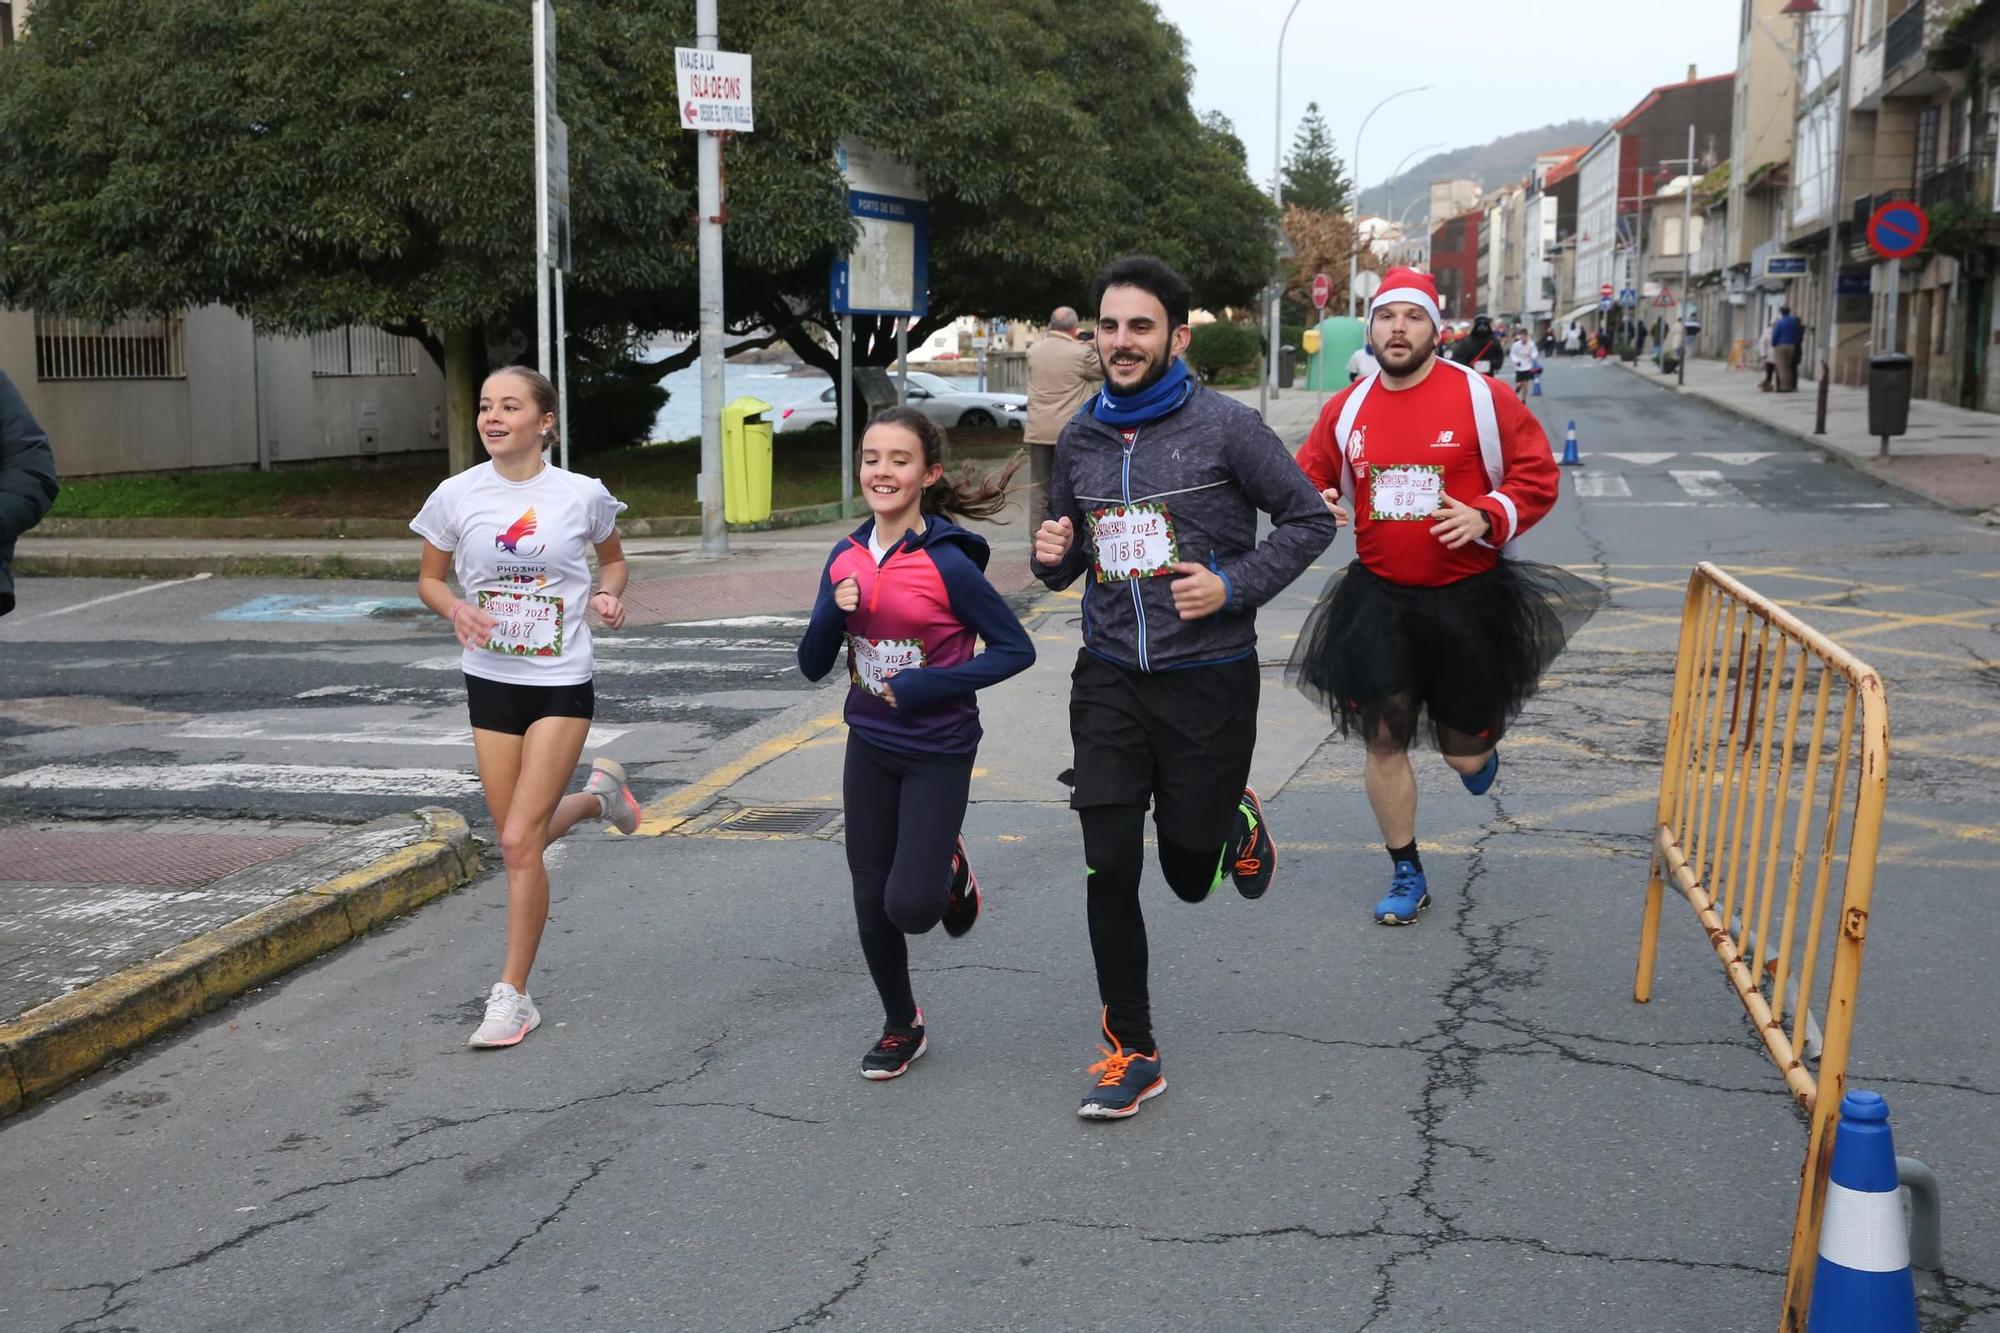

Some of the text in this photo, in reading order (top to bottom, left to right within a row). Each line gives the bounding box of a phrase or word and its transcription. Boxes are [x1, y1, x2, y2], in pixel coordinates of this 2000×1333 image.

[678, 51, 714, 71] VIAJE A LA
[1393, 491, 1415, 506] 59
[1111, 539, 1145, 562] 155
[501, 620, 534, 638] 137
